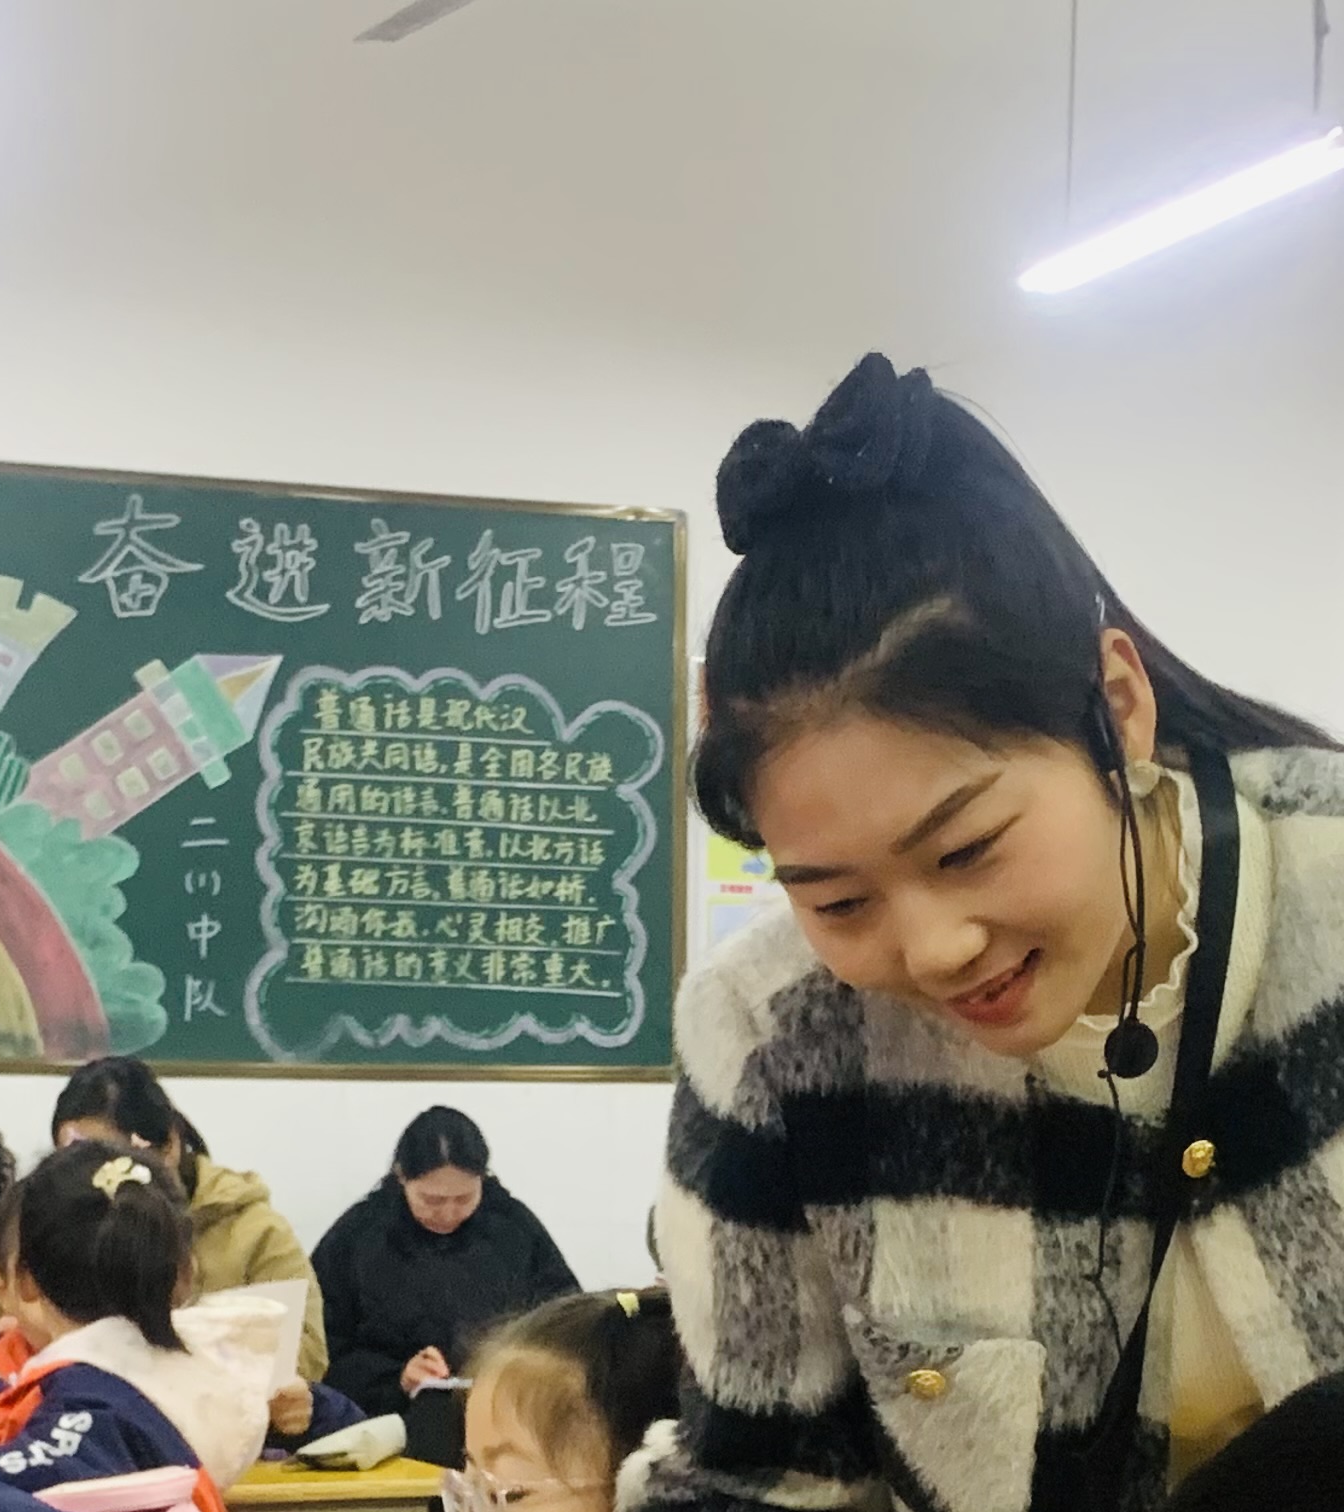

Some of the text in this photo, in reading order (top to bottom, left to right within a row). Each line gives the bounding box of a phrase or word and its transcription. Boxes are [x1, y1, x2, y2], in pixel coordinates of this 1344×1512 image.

[78, 494, 658, 635] 奋进新征程
